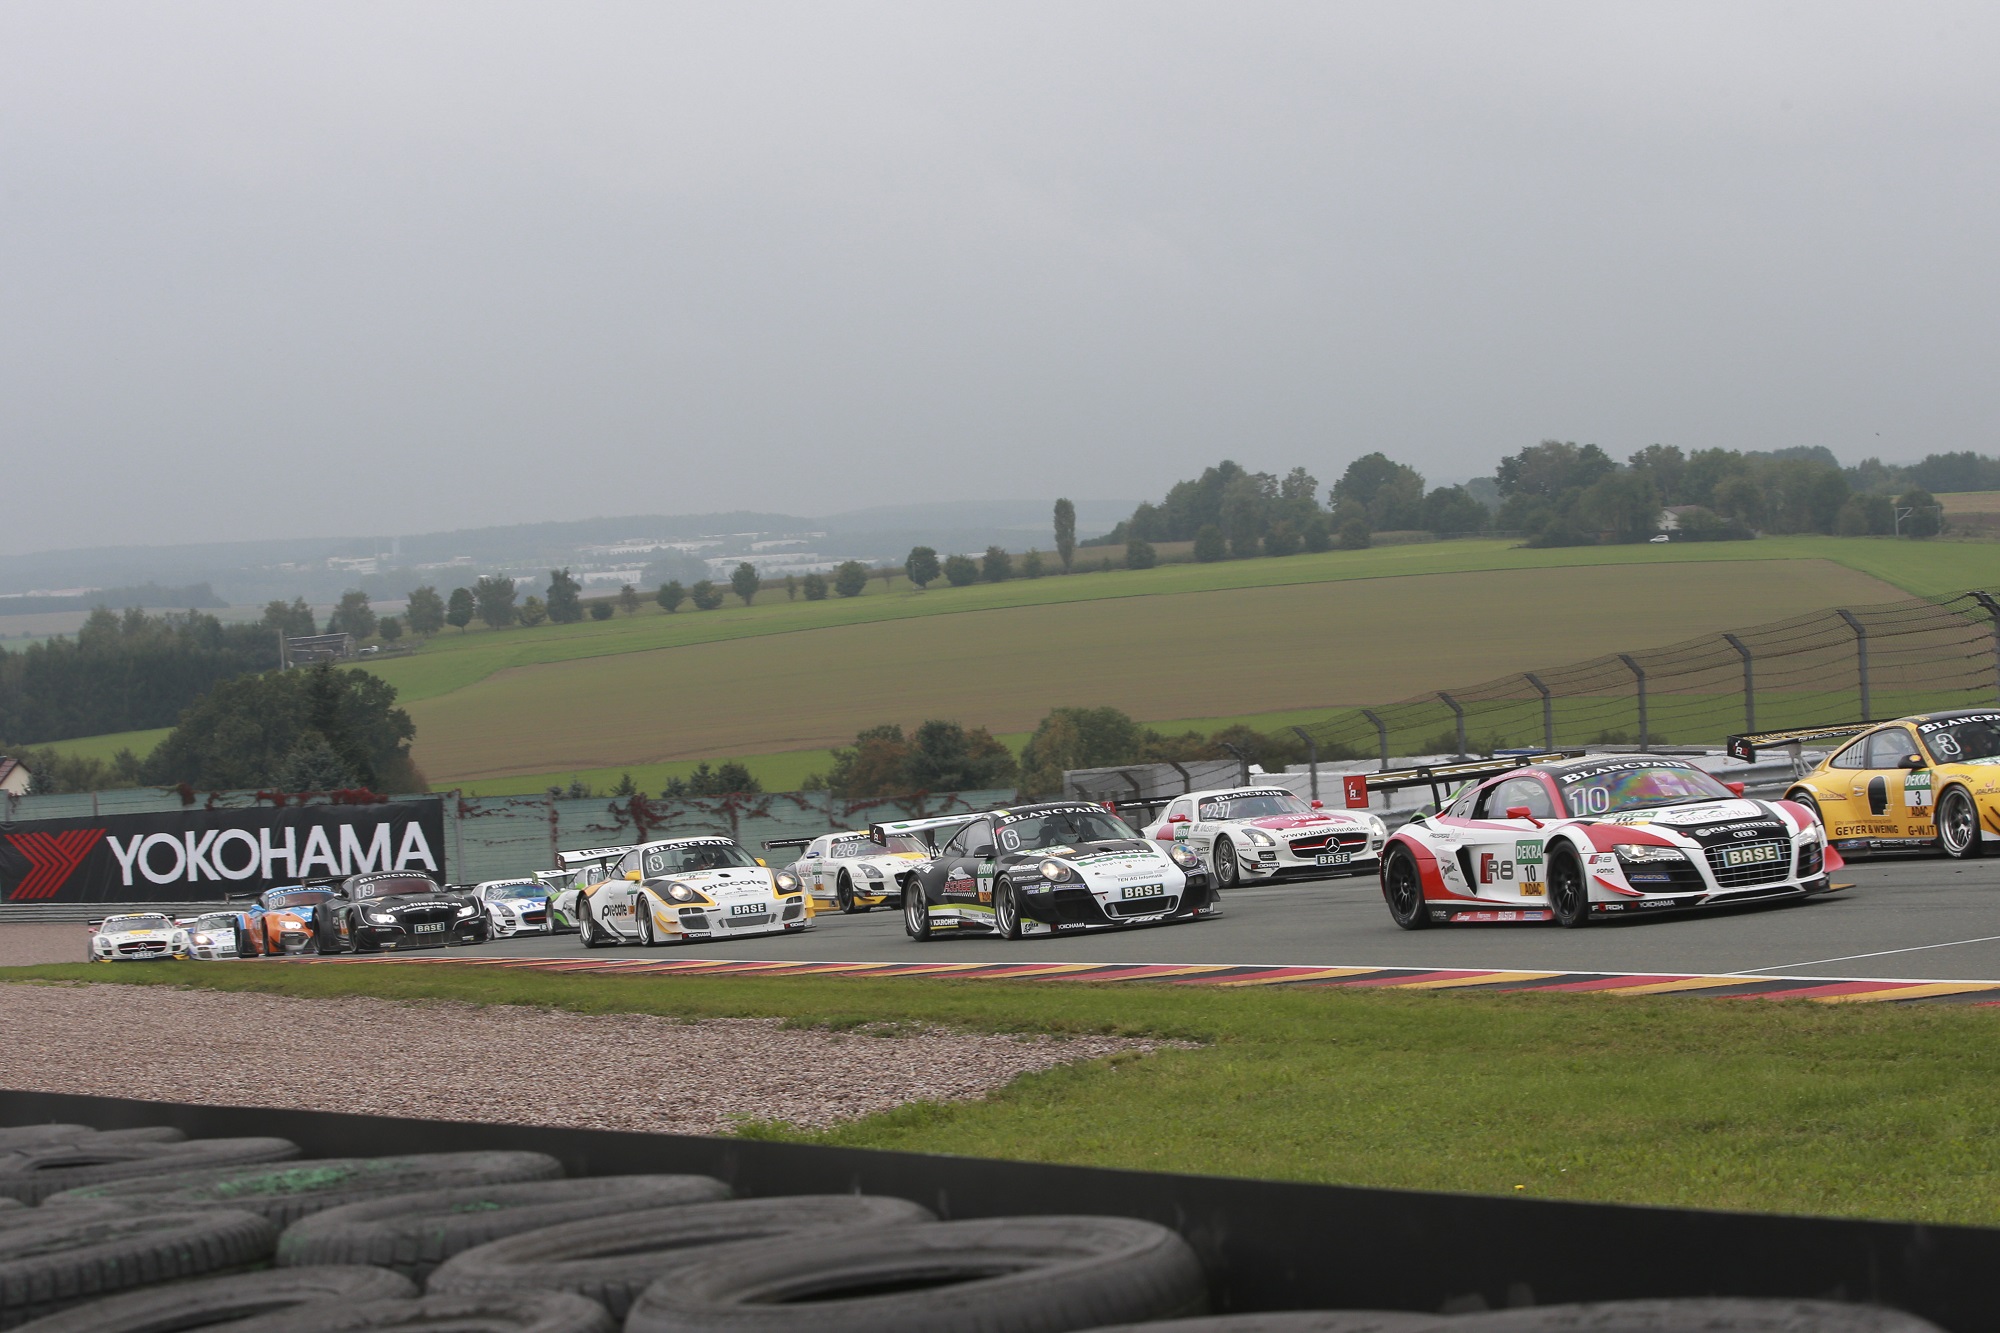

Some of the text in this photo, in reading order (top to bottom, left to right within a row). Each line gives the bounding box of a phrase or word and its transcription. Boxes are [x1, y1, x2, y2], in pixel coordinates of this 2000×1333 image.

[1935, 733, 1961, 755] 3
[1560, 761, 1691, 785] BLANCPAIN
[1905, 773, 1931, 786] DEKRA
[1214, 791, 1283, 802] BLANCPAIN
[1569, 786, 1610, 818] 10
[1915, 790, 1922, 805] 3
[1001, 806, 1107, 825] BLANCPAIN
[1602, 811, 1654, 819] DEKRA
[1911, 806, 1928, 817] ADAC
[1728, 820, 1780, 831] INSTITUTE
[1835, 825, 1899, 836] GEYER & WEINIG
[1908, 825, 1936, 836] G-W.IT
[1001, 829, 1021, 851] 6
[106, 821, 438, 886] YOKOHAMA
[647, 840, 734, 855] BLANCPAIN
[835, 842, 859, 858] 23
[1516, 844, 1543, 860] DEKRA
[1077, 853, 1160, 867] LOWA
[1319, 854, 1348, 864] BASE
[1730, 846, 1776, 865] BASE
[649, 854, 664, 872] 8
[977, 863, 993, 875] DEKRA
[359, 873, 427, 884] BLANCPAIN
[1524, 864, 1536, 882] 10
[356, 883, 375, 899] 19
[701, 879, 768, 893] precote
[982, 878, 988, 892] 6
[1124, 884, 1162, 898] BASE
[1524, 883, 1542, 896] ADAC
[268, 896, 286, 911] 20
[733, 903, 765, 915] BASE
[1639, 900, 1676, 908] YOKOHAMA
[602, 902, 628, 921] precote
[417, 923, 442, 932] BASE
[1058, 922, 1086, 930] YOKOHAMA
